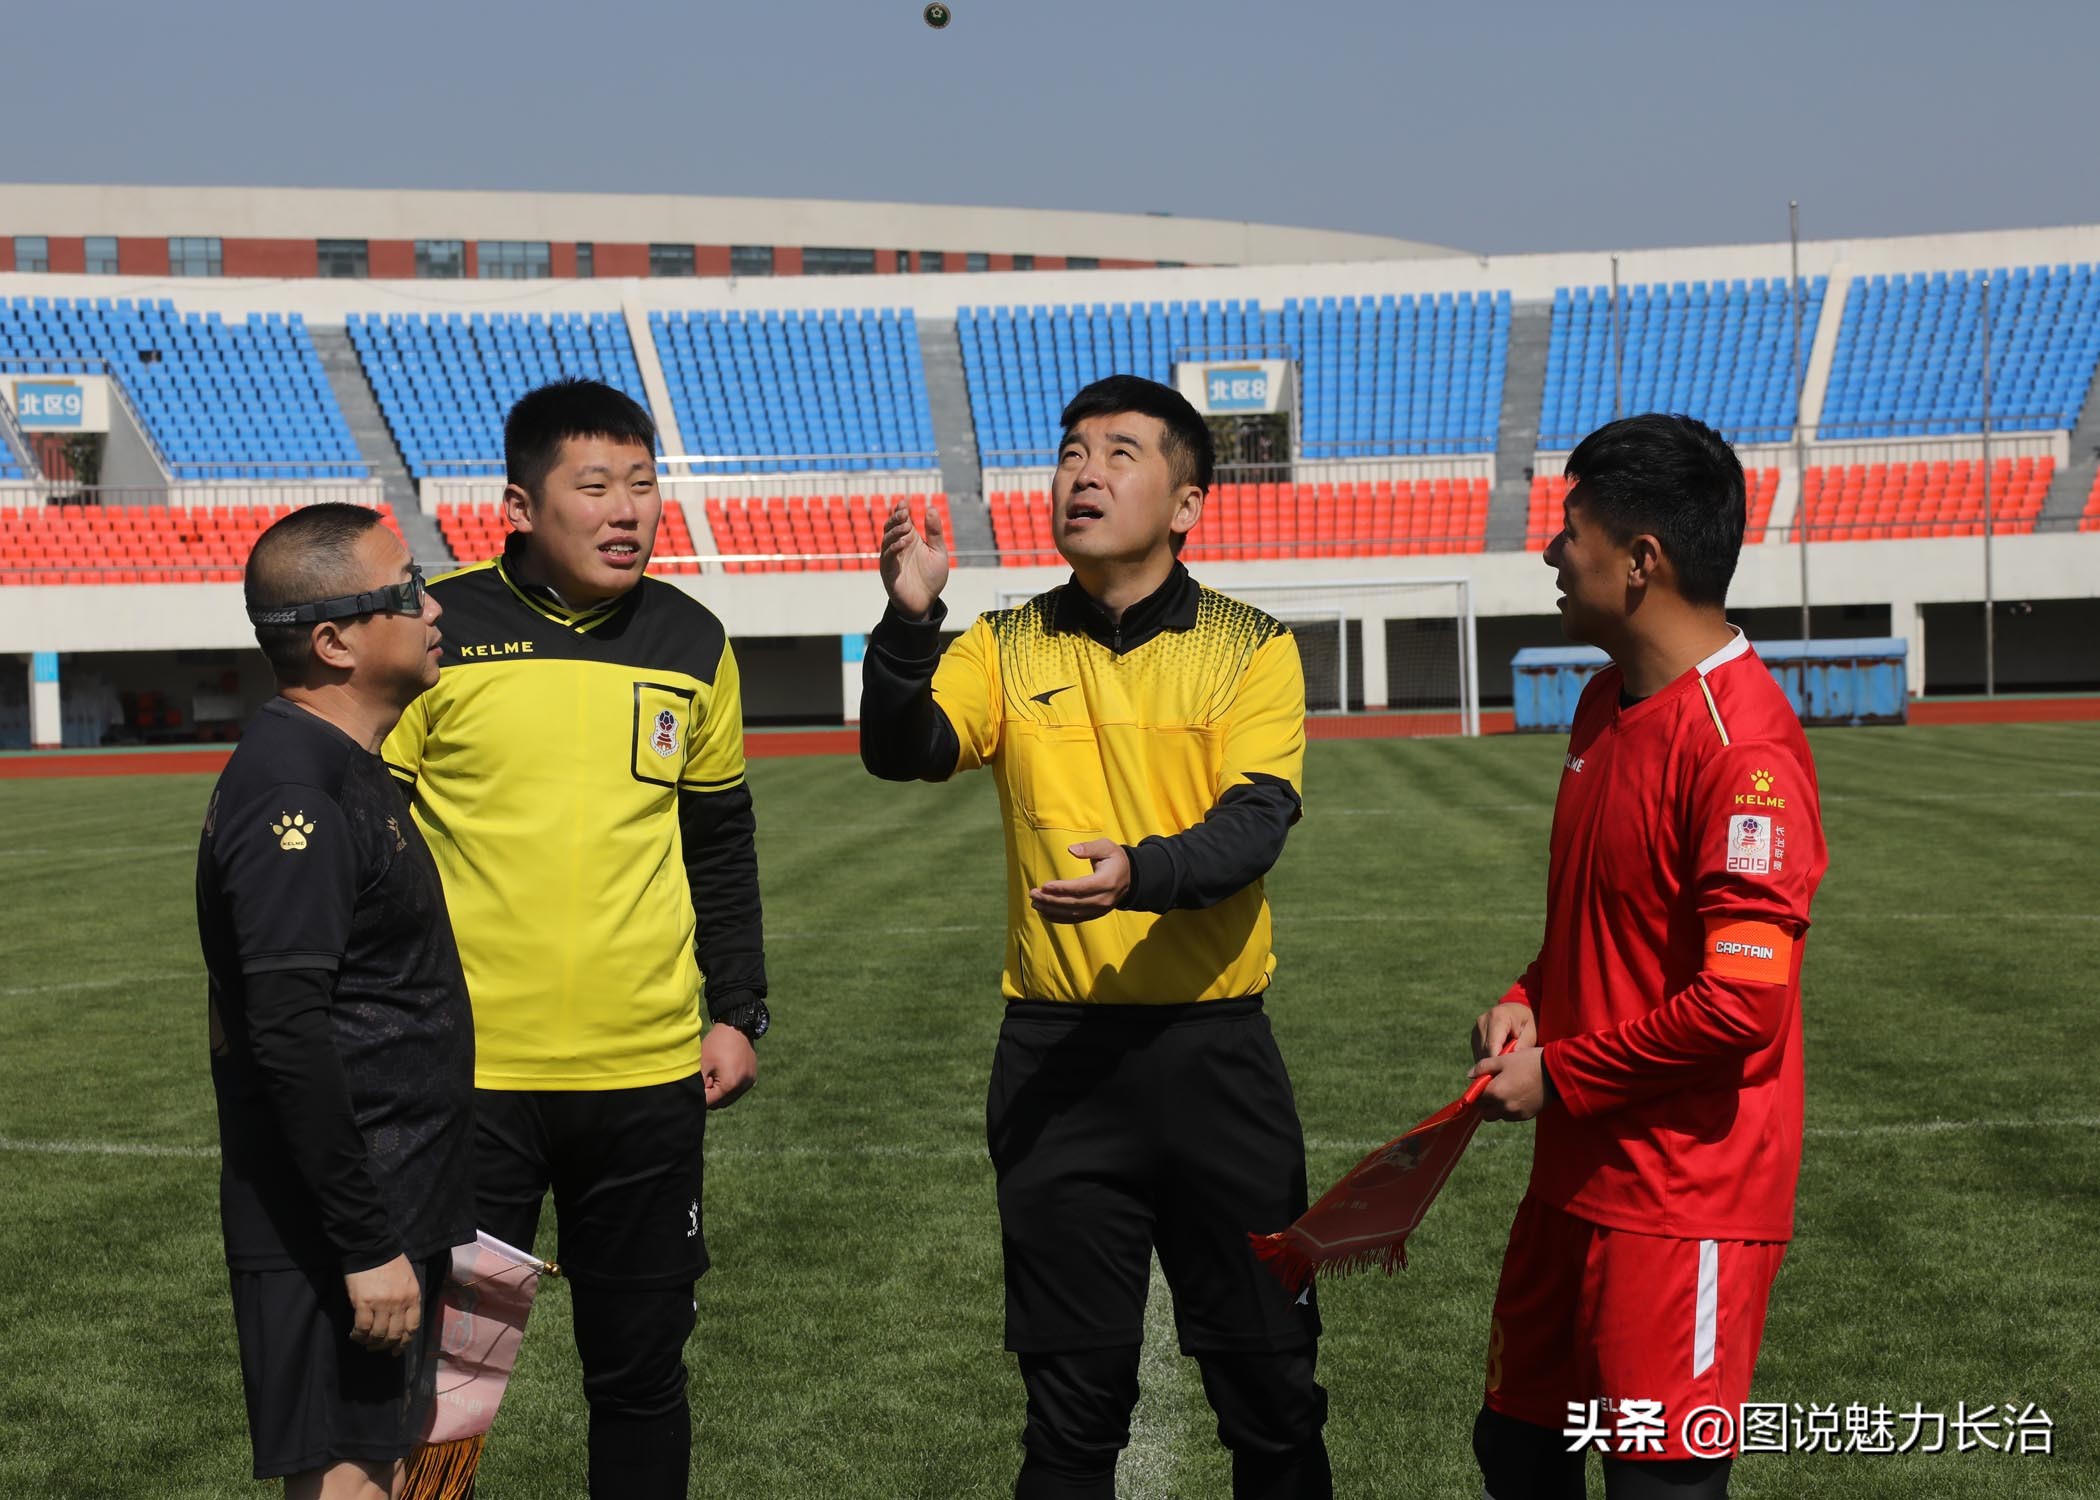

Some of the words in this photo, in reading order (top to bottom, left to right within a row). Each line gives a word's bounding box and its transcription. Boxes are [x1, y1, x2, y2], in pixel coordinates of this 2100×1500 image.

[1210, 379, 1266, 400] 北区8
[20, 393, 81, 415] 北区9
[461, 641, 534, 657] KELME
[1735, 794, 1786, 808] KELME
[1728, 857, 1767, 871] 2019
[1716, 941, 1773, 960] CAPTAIN
